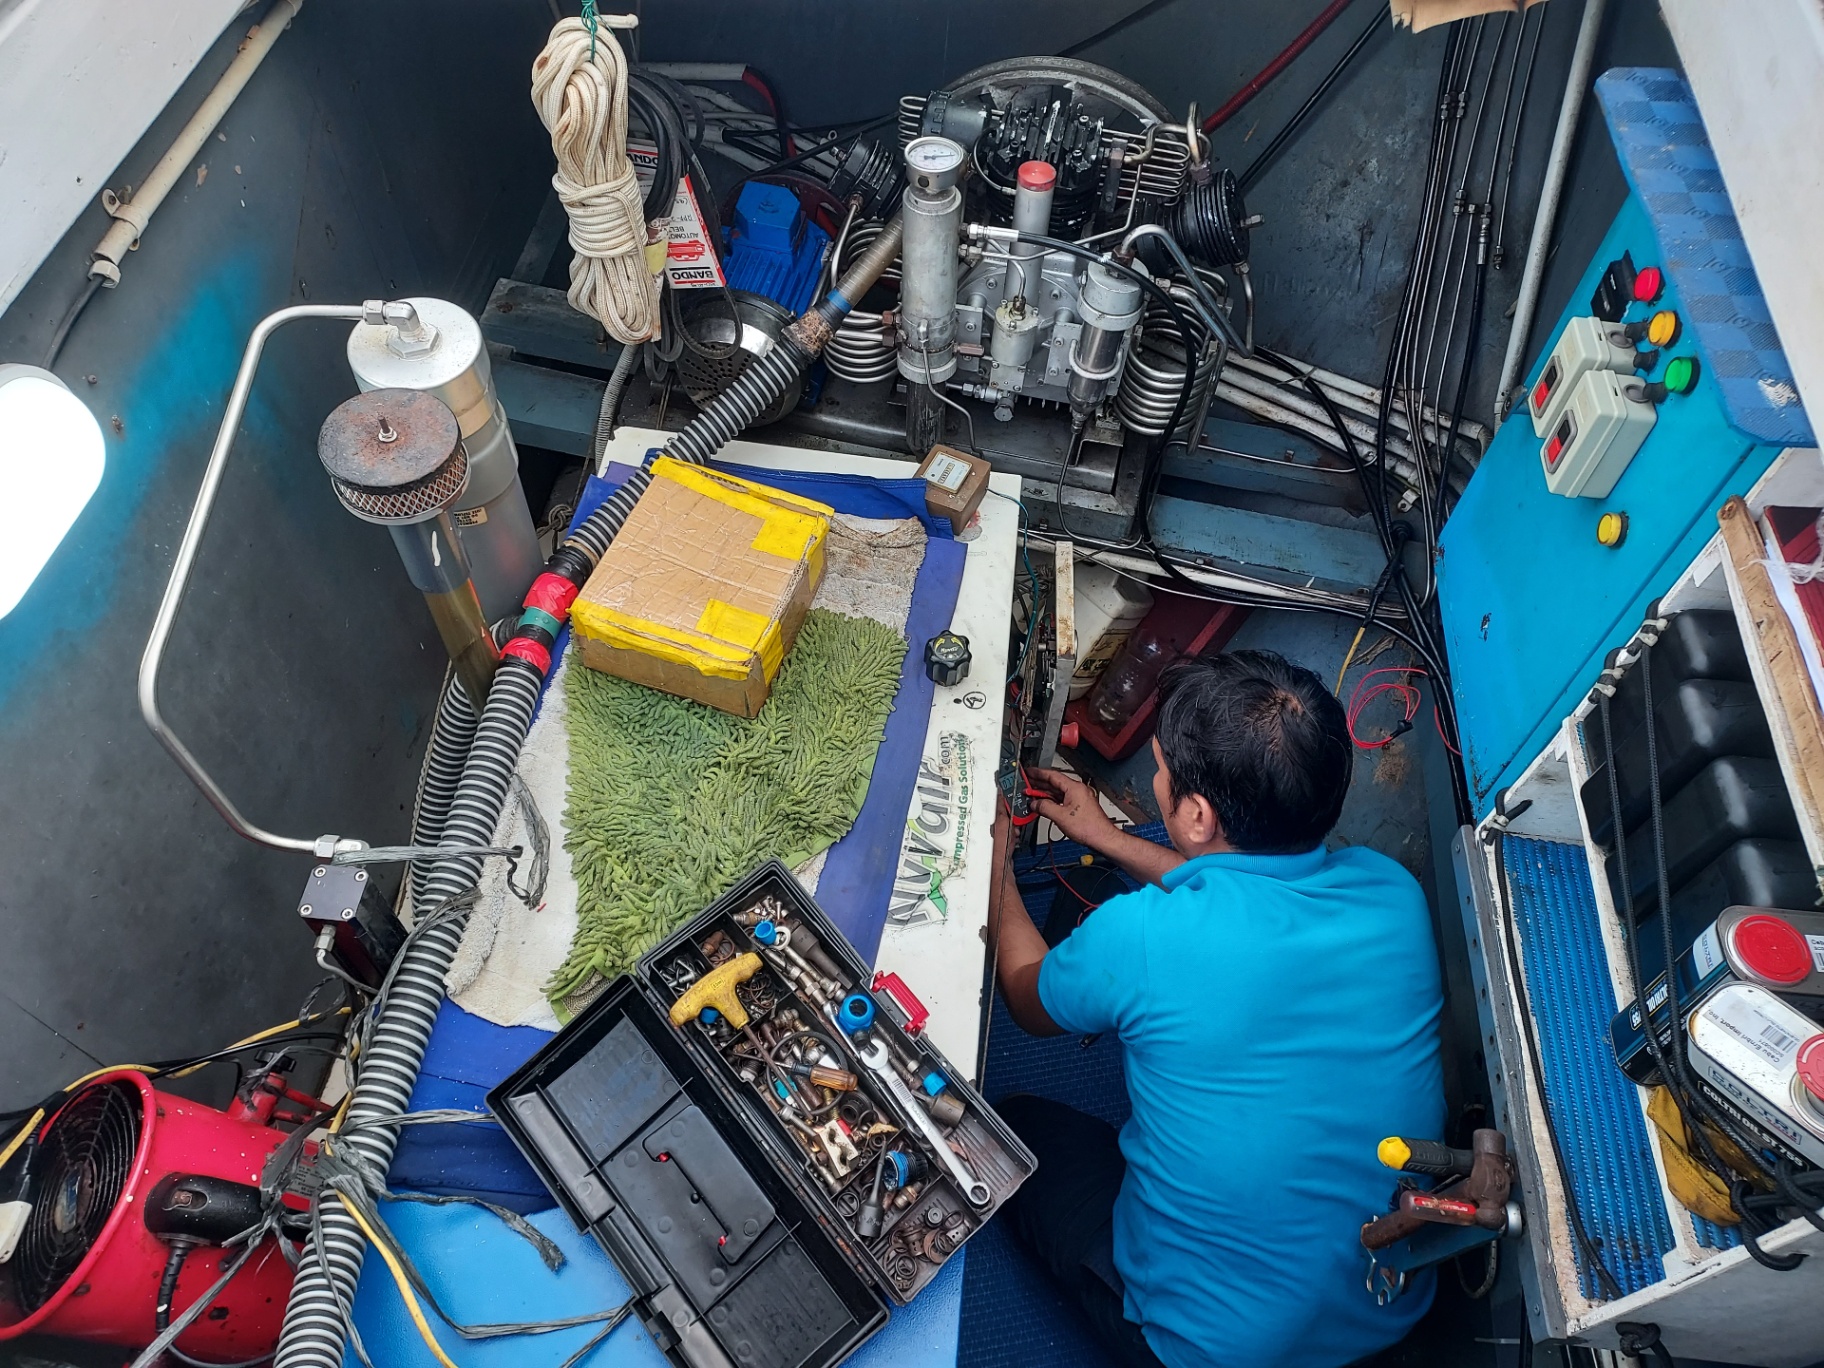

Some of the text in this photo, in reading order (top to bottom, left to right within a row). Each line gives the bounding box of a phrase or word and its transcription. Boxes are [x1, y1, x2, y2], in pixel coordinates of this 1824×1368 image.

[626, 153, 659, 166] ANDO
[668, 232, 699, 240] AUTOMO
[671, 270, 713, 280] BANDO
[959, 786, 968, 804] Gas
[1761, 1048, 1781, 1064] Cebu
[1702, 1085, 1803, 1168] COLTRI OIL ST 755
